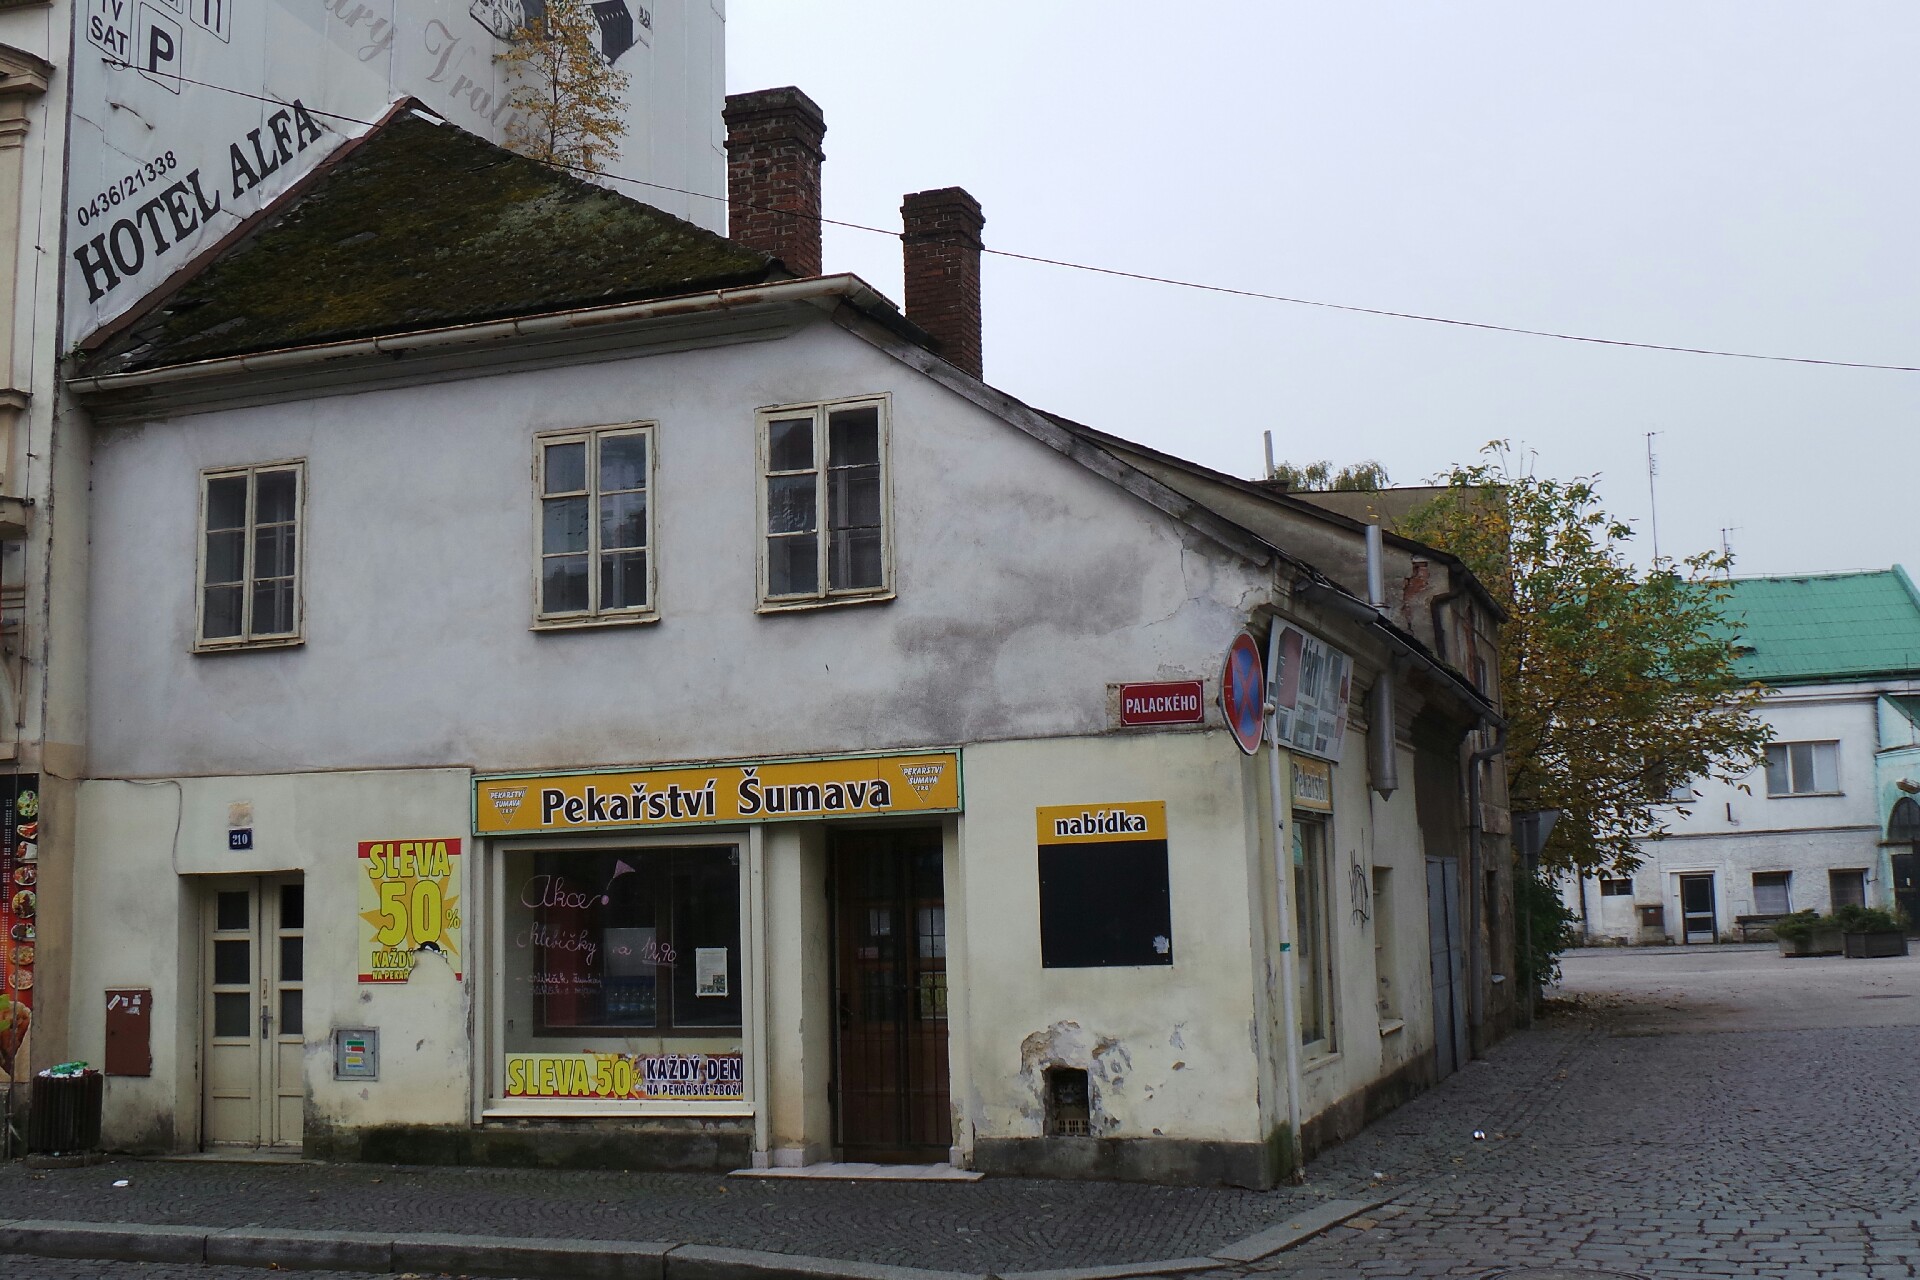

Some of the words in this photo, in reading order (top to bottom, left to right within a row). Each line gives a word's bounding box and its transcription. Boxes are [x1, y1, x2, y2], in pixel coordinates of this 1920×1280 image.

[90, 15, 129, 56] SAT
[148, 24, 175, 73] P
[72, 168, 221, 304] HOTEL
[229, 98, 322, 200] ALFA
[77, 150, 177, 227] 0436/21338
[1126, 693, 1198, 714] PALACKÉHO
[541, 778, 717, 825] Pekařství
[737, 766, 892, 815] Šumava
[232, 833, 248, 845] 210
[1055, 809, 1148, 836] nabídka
[368, 841, 451, 880] SLEVA
[520, 874, 601, 909] Akce
[371, 948, 415, 969] KAŽDÝ
[508, 1059, 591, 1096] SLEVA
[645, 1054, 700, 1081] KAŽDÝ
[707, 1058, 741, 1081] DEN
[646, 1083, 659, 1096] NA
[662, 1081, 710, 1096] PEKAŘSKÉ
[713, 1081, 742, 1096] ZBOŽÍ
